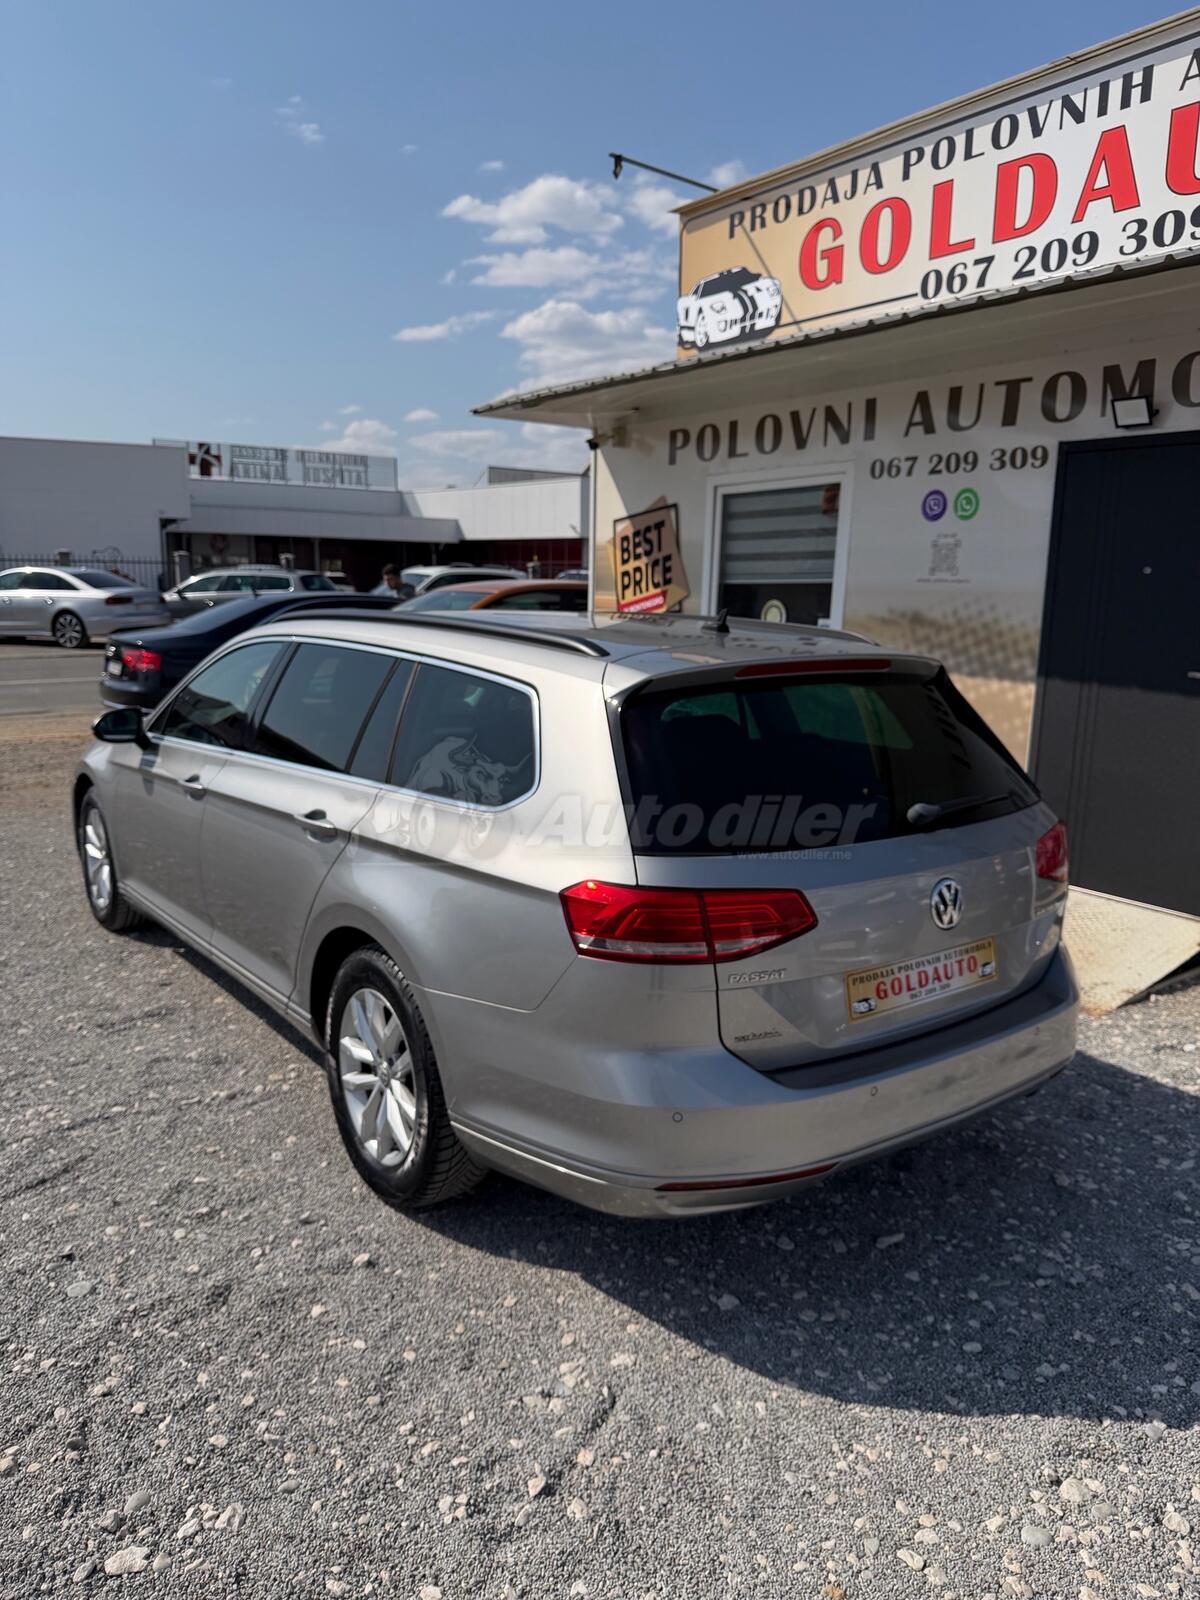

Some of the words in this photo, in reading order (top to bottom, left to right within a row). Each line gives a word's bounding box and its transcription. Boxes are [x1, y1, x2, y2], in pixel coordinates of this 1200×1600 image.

[728, 161, 885, 240] PRODAJA
[902, 64, 1155, 182] POLOVNIH
[920, 255, 996, 301] 067
[1012, 230, 1101, 282] 209
[668, 397, 878, 466] POLOVNI
[869, 454, 919, 480] 067
[928, 449, 979, 476] 209
[989, 445, 1050, 472] 309
[621, 520, 665, 565] BEST
[621, 555, 672, 600] PRICE
[728, 967, 788, 985] PASSAT
[852, 969, 896, 986] PRODAJA
[875, 954, 978, 1001] GOLDAUTO
